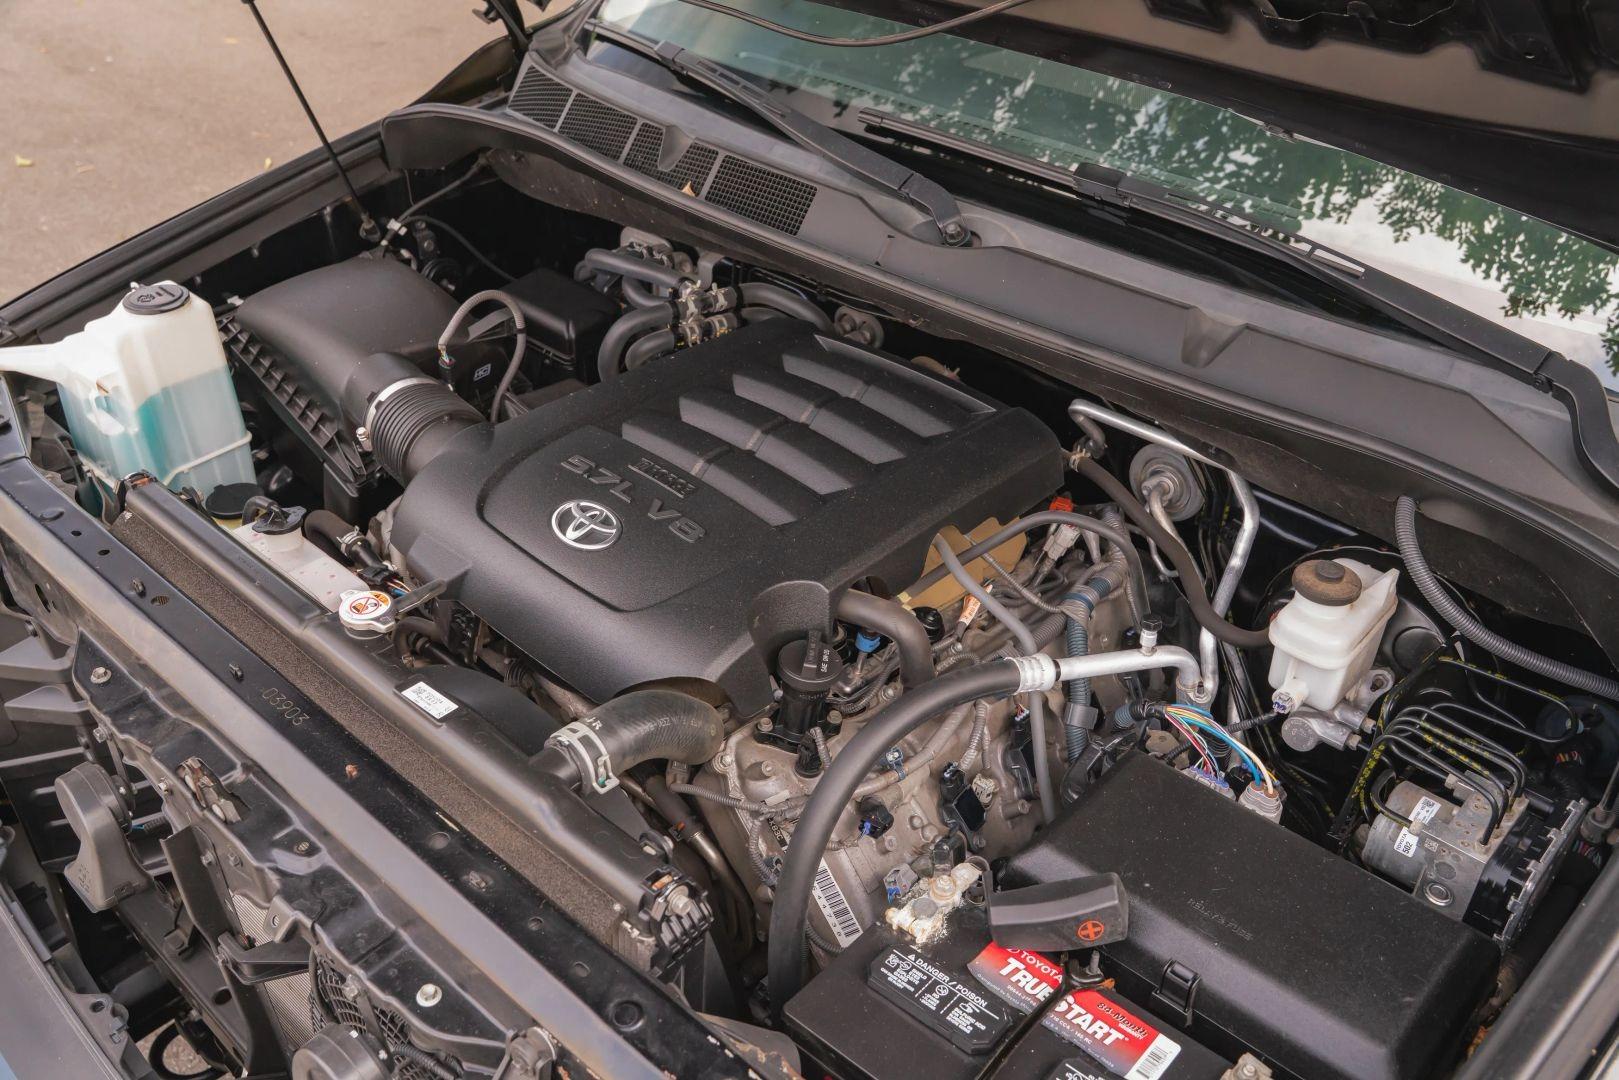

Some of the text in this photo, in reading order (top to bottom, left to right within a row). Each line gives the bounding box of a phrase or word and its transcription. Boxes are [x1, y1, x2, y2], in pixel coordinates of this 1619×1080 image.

[561, 454, 706, 544] 5.7L V8
[262, 687, 310, 726] 03903
[1395, 832, 1408, 851] TOYOTA
[1402, 841, 1412, 855] 502
[915, 959, 951, 983] DANGER
[956, 984, 988, 1008] POISON
[1020, 950, 1063, 984] TOYOTA
[1000, 956, 1126, 1046] TRUE START
